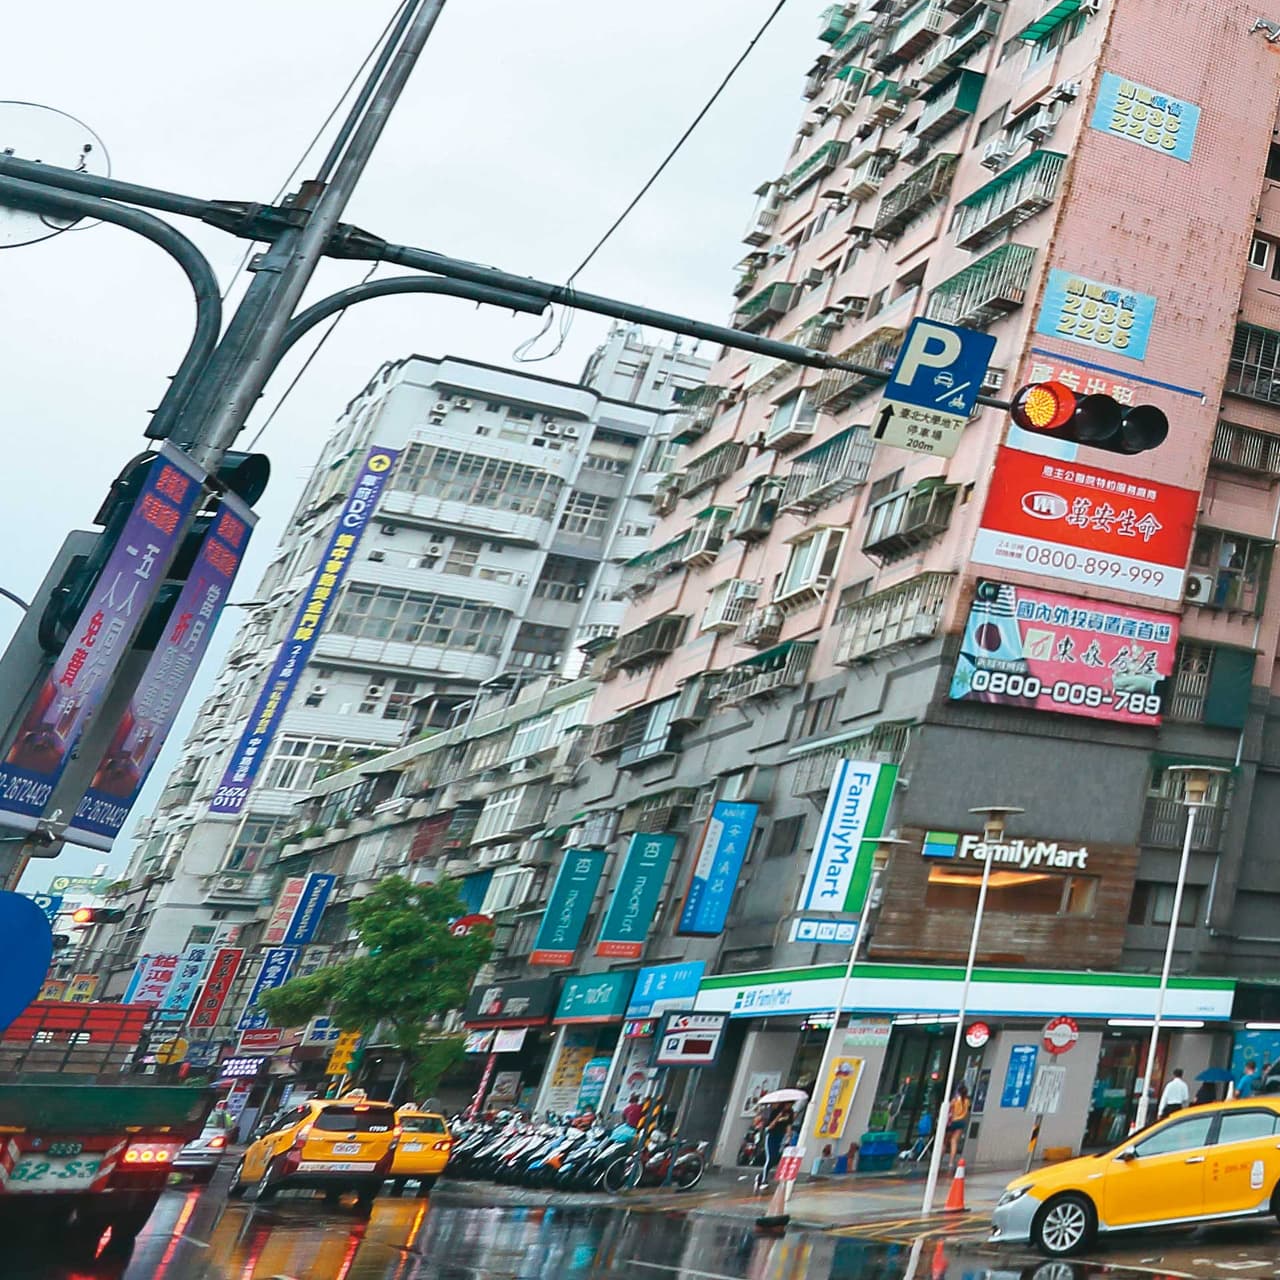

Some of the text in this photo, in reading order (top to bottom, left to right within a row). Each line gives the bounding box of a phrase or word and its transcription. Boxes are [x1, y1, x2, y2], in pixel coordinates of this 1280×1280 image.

[894, 322, 962, 386] P
[906, 424, 942, 441] 停車場
[906, 438, 934, 452] 200m
[1065, 496, 1163, 543] 萬安生命
[1025, 545, 1164, 588] 0800-899-999
[1053, 636, 1159, 673] 東森房屋
[971, 670, 1161, 715] 0800-009-789
[820, 773, 872, 898] FamilyMart
[959, 834, 1088, 869] FamilyMart
[294, 879, 328, 939] Panasonic
